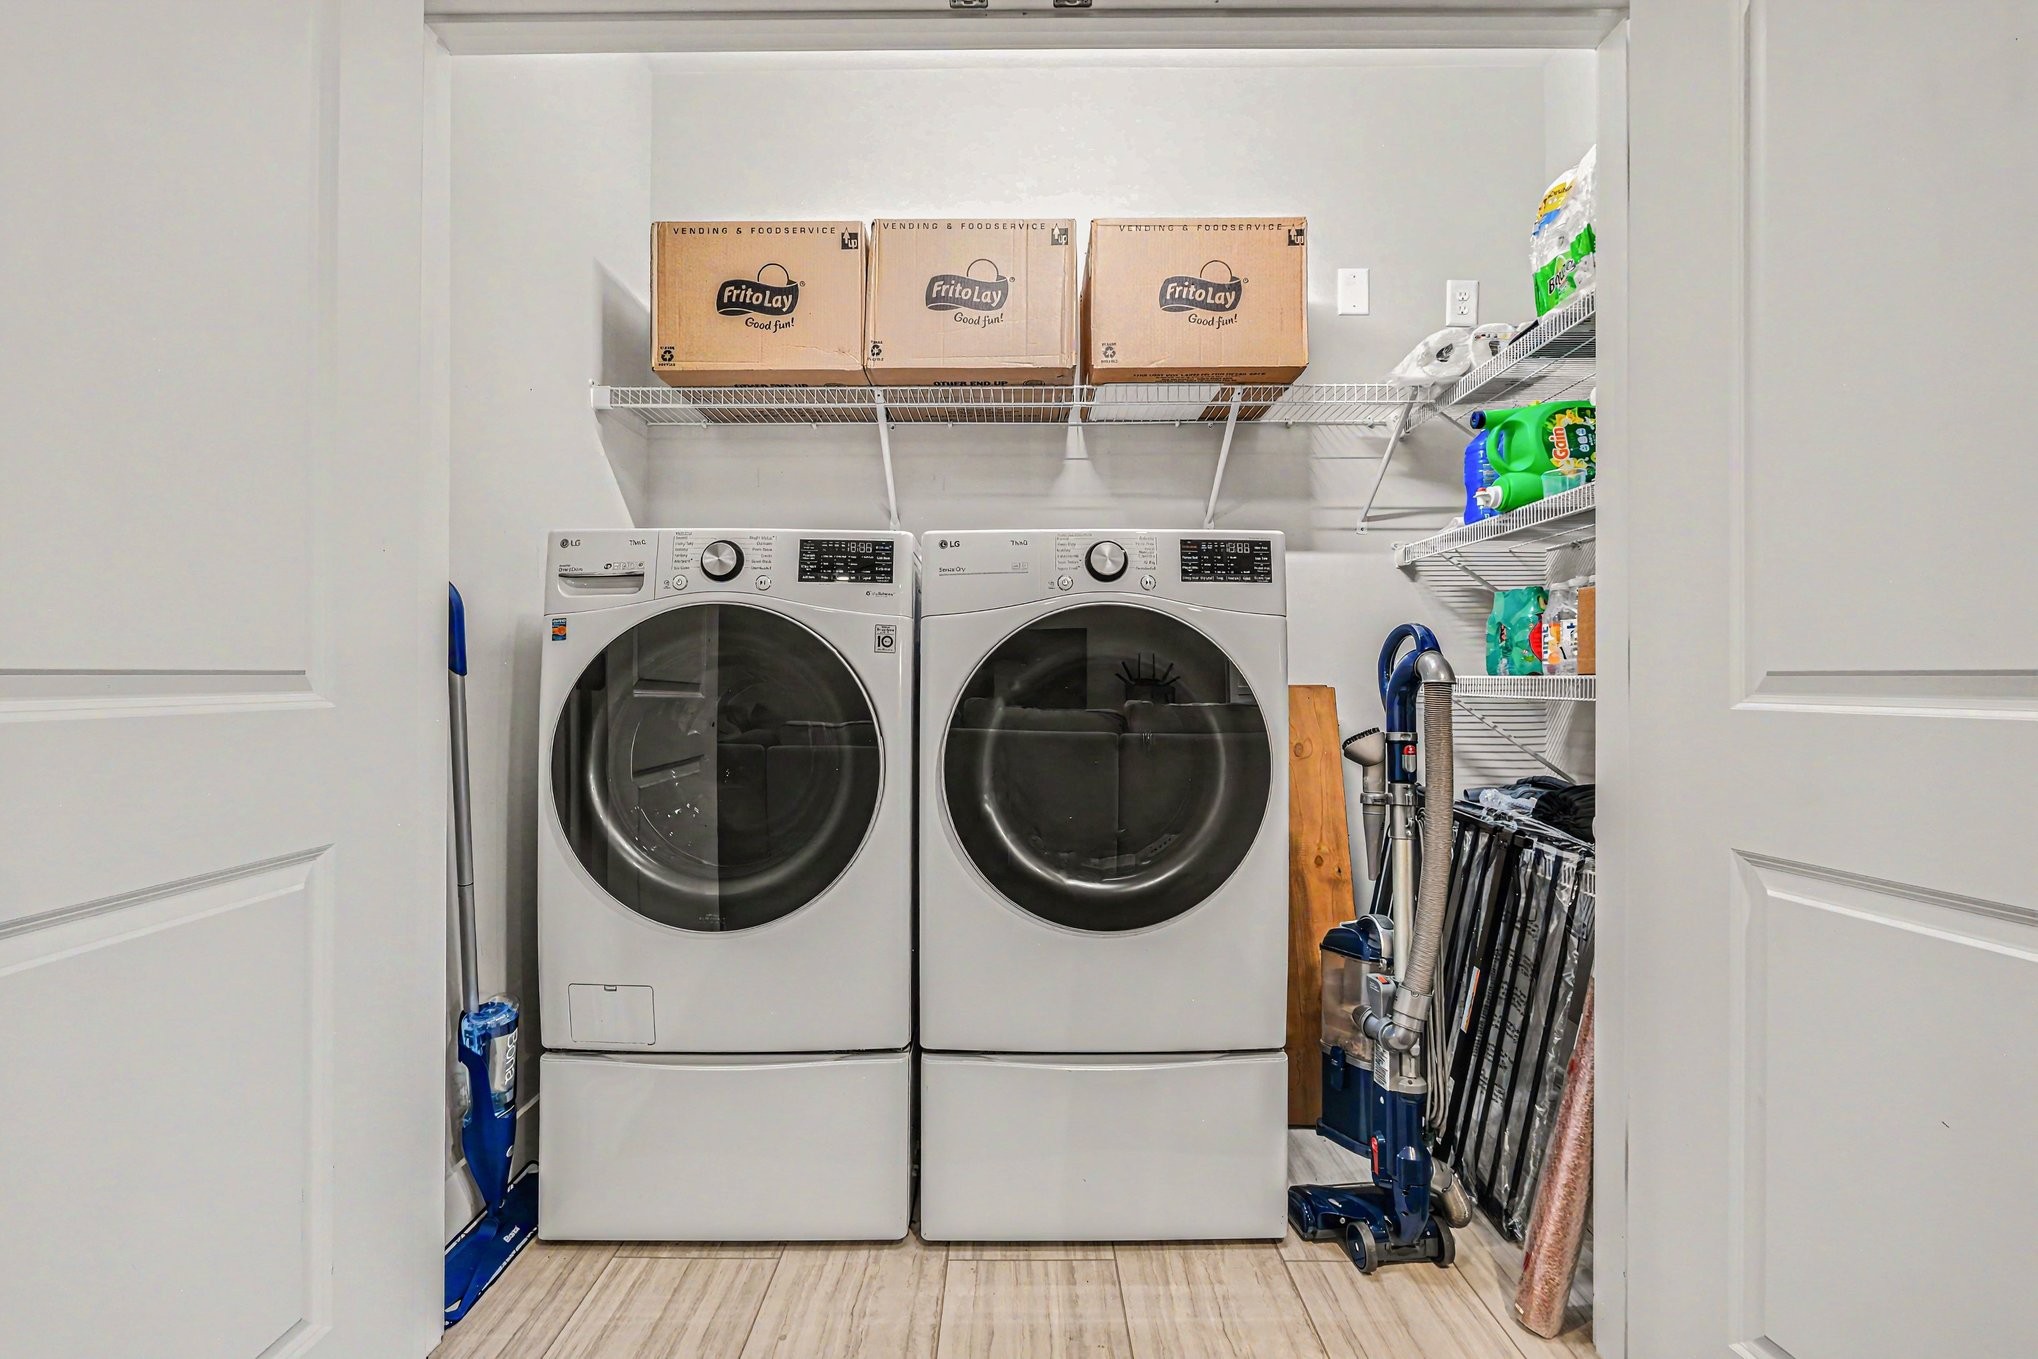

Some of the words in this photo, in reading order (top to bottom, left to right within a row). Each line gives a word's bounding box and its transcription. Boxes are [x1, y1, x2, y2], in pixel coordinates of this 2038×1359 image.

[673, 227, 728, 235] VENDING
[735, 227, 742, 235] &
[750, 227, 836, 235] FOODSERVICE
[882, 222, 938, 230] VENDING
[946, 222, 952, 230] &
[961, 222, 1046, 230] FOODSERVICE
[1119, 224, 1174, 232] VENDING
[1196, 223, 1282, 231] FOODSERVICE
[745, 317, 772, 331] Good
[772, 317, 795, 333] fun!
[953, 312, 980, 326] Good
[981, 312, 1004, 328] fun!
[1188, 313, 1215, 327] Good
[1215, 313, 1238, 329] fun!
[1548, 426, 1570, 460] Gain
[505, 1027, 518, 1085] Bona
